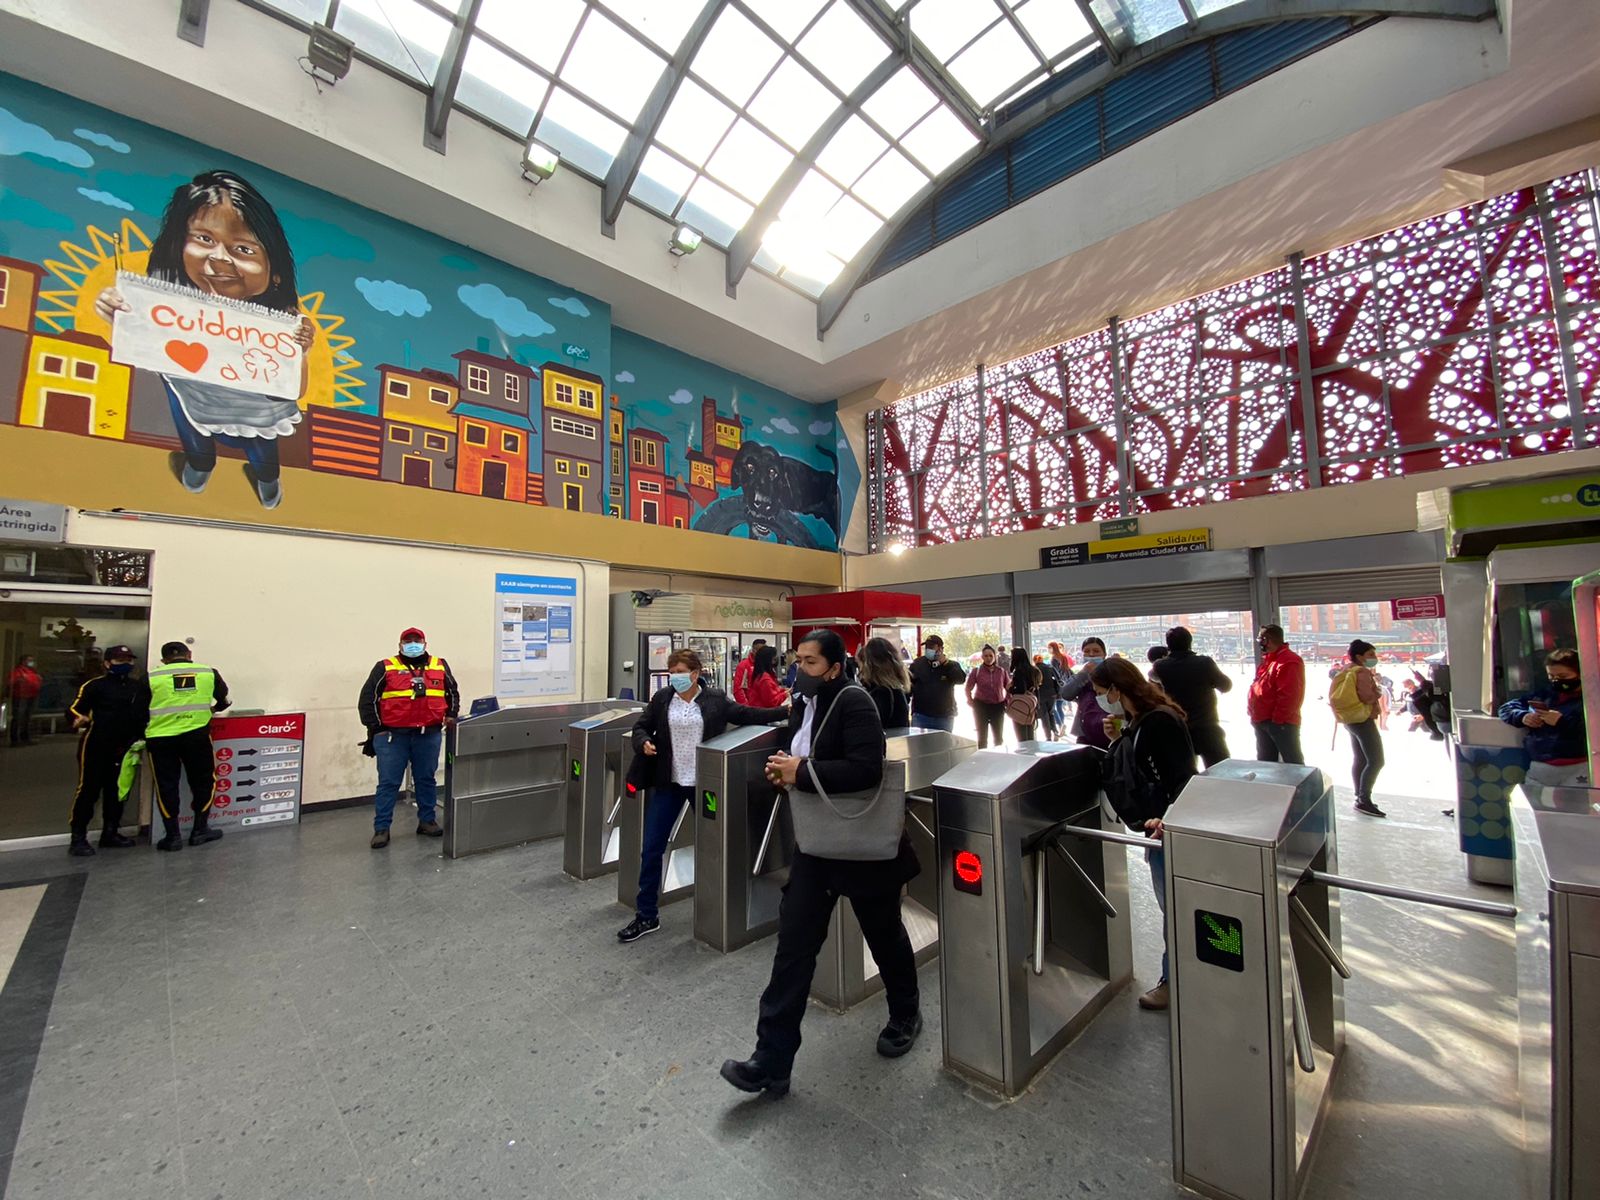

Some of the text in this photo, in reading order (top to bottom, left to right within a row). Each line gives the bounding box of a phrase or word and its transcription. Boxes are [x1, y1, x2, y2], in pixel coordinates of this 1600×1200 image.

[0, 505, 32, 518] Área
[1050, 547, 1079, 556] Gracias
[1119, 549, 1149, 558] Avenida
[1150, 546, 1176, 555] Ciudad
[742, 621, 752, 629] en
[258, 724, 292, 734] Claro
[222, 809, 244, 818] Pago
